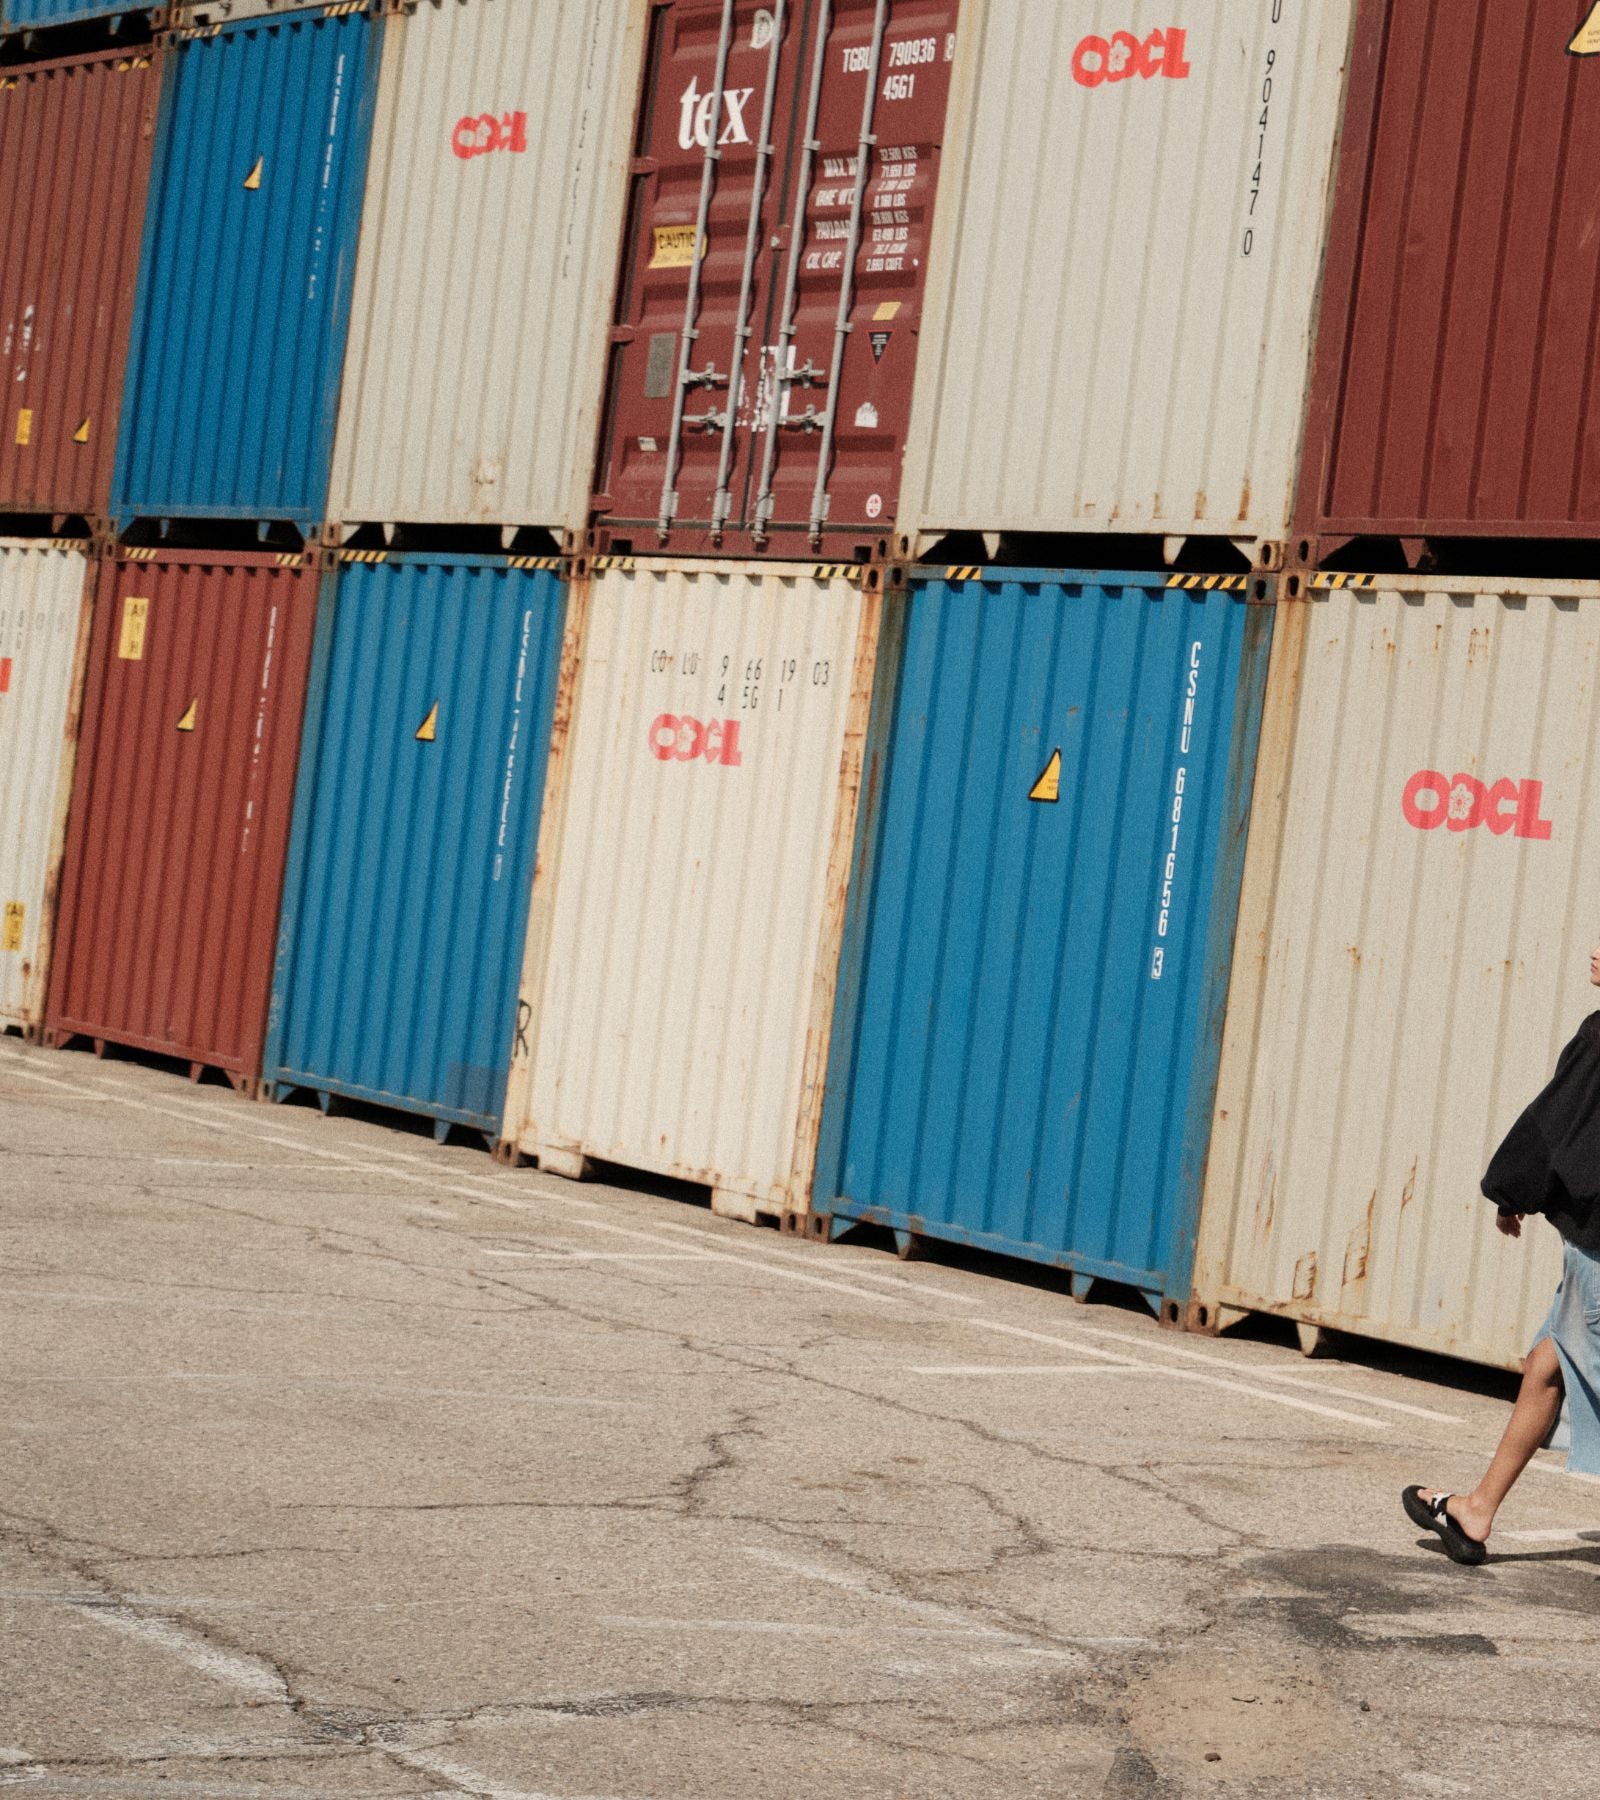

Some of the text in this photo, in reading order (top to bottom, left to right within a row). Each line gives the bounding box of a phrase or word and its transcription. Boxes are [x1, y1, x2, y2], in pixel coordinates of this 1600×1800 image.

[883, 73, 915, 100] 45G1
[888, 38, 936, 67] 790936
[1251, 50, 1276, 215] 904147
[1180, 641, 1202, 753] CSNU
[1401, 769, 1553, 841] OOCL
[1157, 768, 1186, 938] 681656
